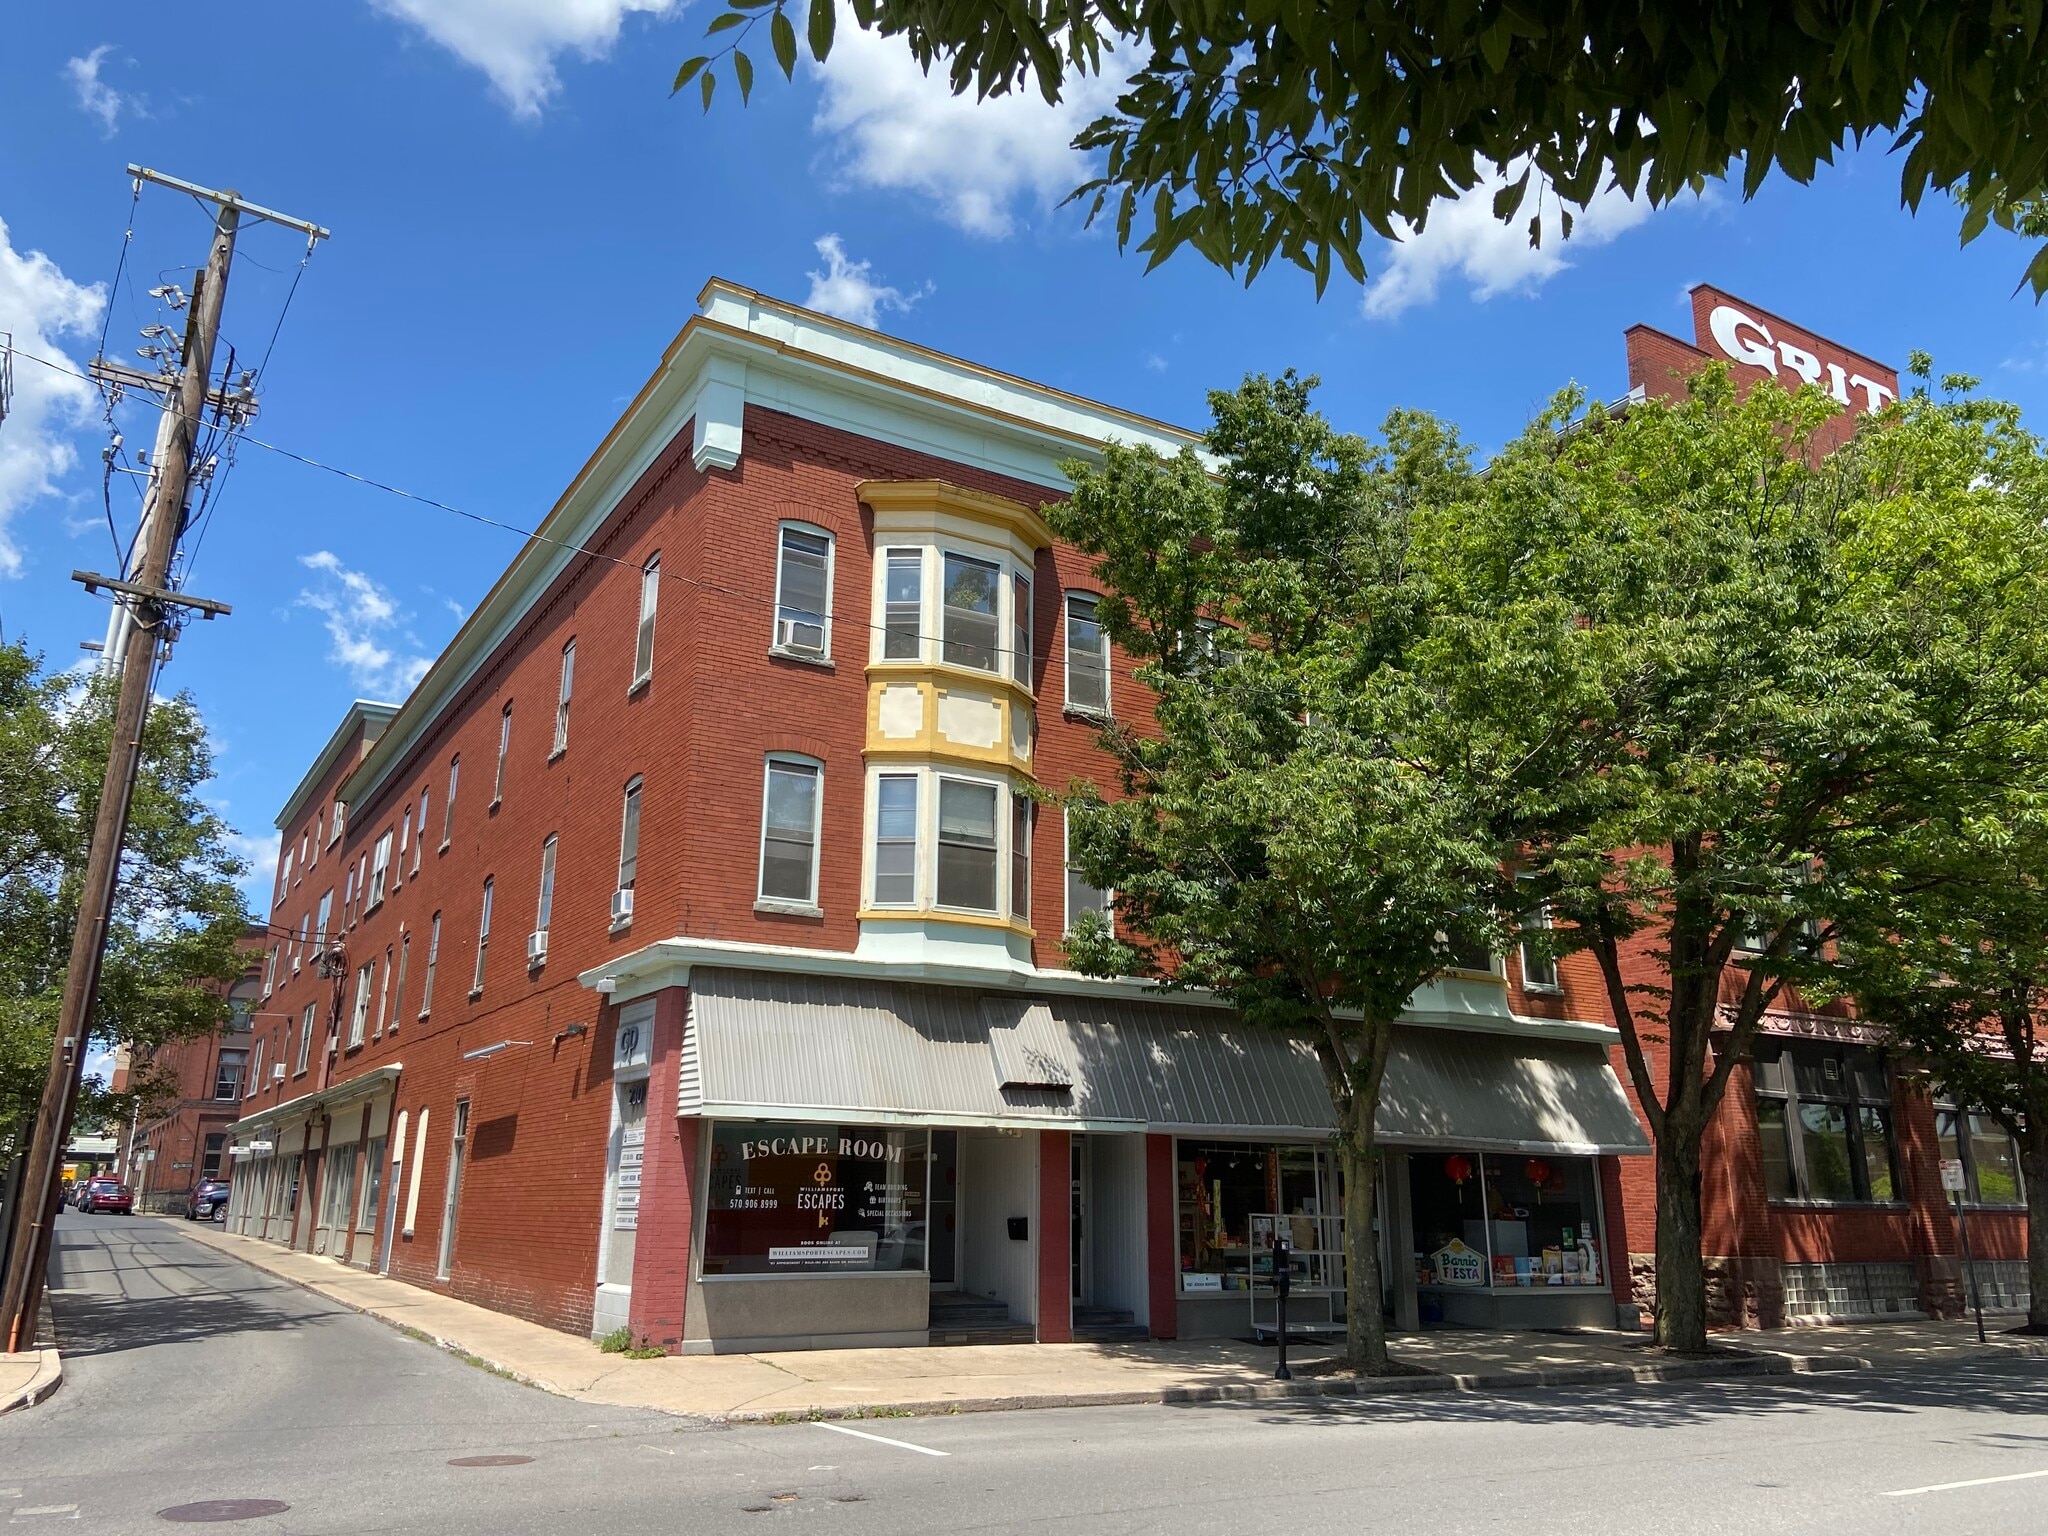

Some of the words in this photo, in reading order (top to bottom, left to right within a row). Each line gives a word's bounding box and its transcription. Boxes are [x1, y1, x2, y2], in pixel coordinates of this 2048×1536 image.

[1709, 305, 1898, 416] GRIT
[741, 1137, 829, 1161] ESCAPE
[838, 1138, 902, 1163] ROOM
[797, 1194, 845, 1209] ESCAPES
[1440, 1253, 1478, 1267] Barrio
